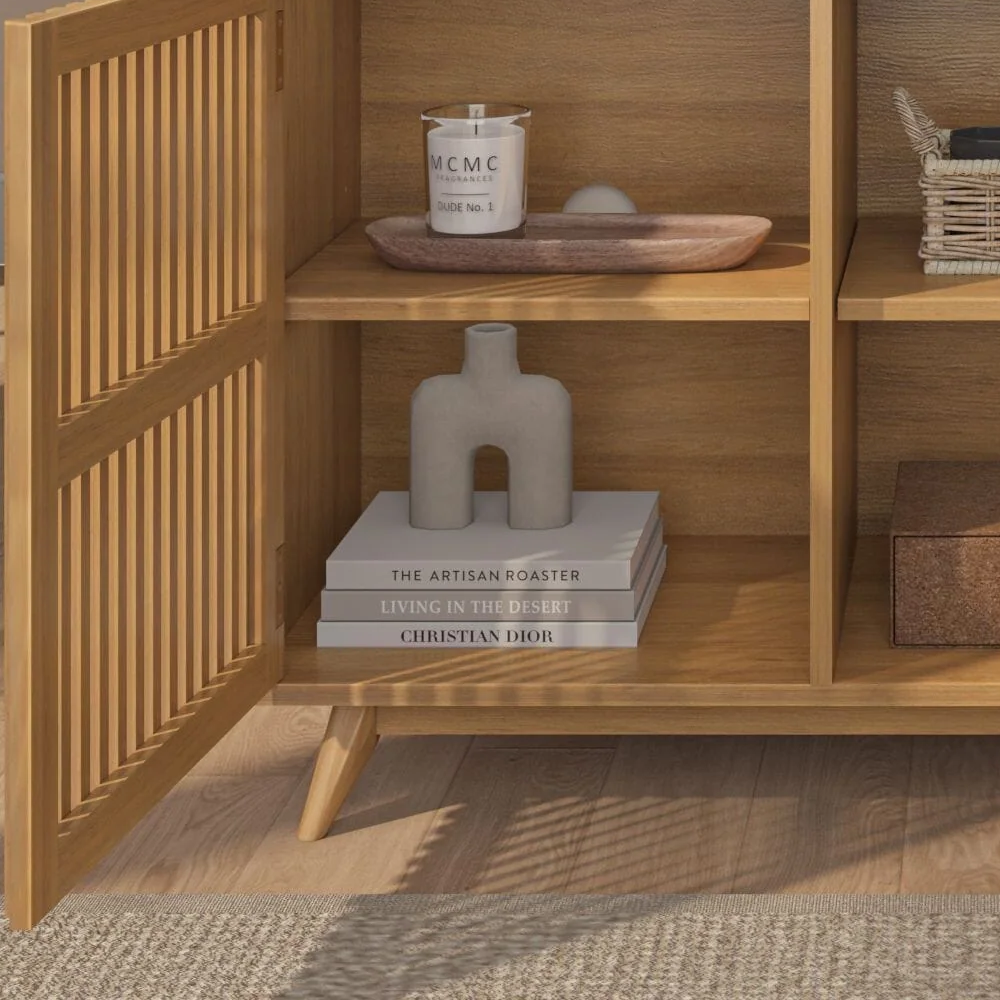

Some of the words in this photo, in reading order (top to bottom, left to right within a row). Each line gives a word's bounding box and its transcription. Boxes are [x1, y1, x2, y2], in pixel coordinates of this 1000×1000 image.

[437, 201, 463, 212] DUDE
[466, 203, 484, 212] No.
[488, 202, 494, 211] 1
[392, 570, 421, 581] THE
[430, 570, 499, 581] ARTISAN
[506, 570, 580, 581] ROASTER
[381, 600, 441, 614] LIVING
[447, 600, 466, 614] IN
[470, 600, 503, 614] THE
[509, 600, 572, 614] DESERT
[400, 630, 500, 643] CHRISTIAN
[507, 630, 553, 643] DIOR
